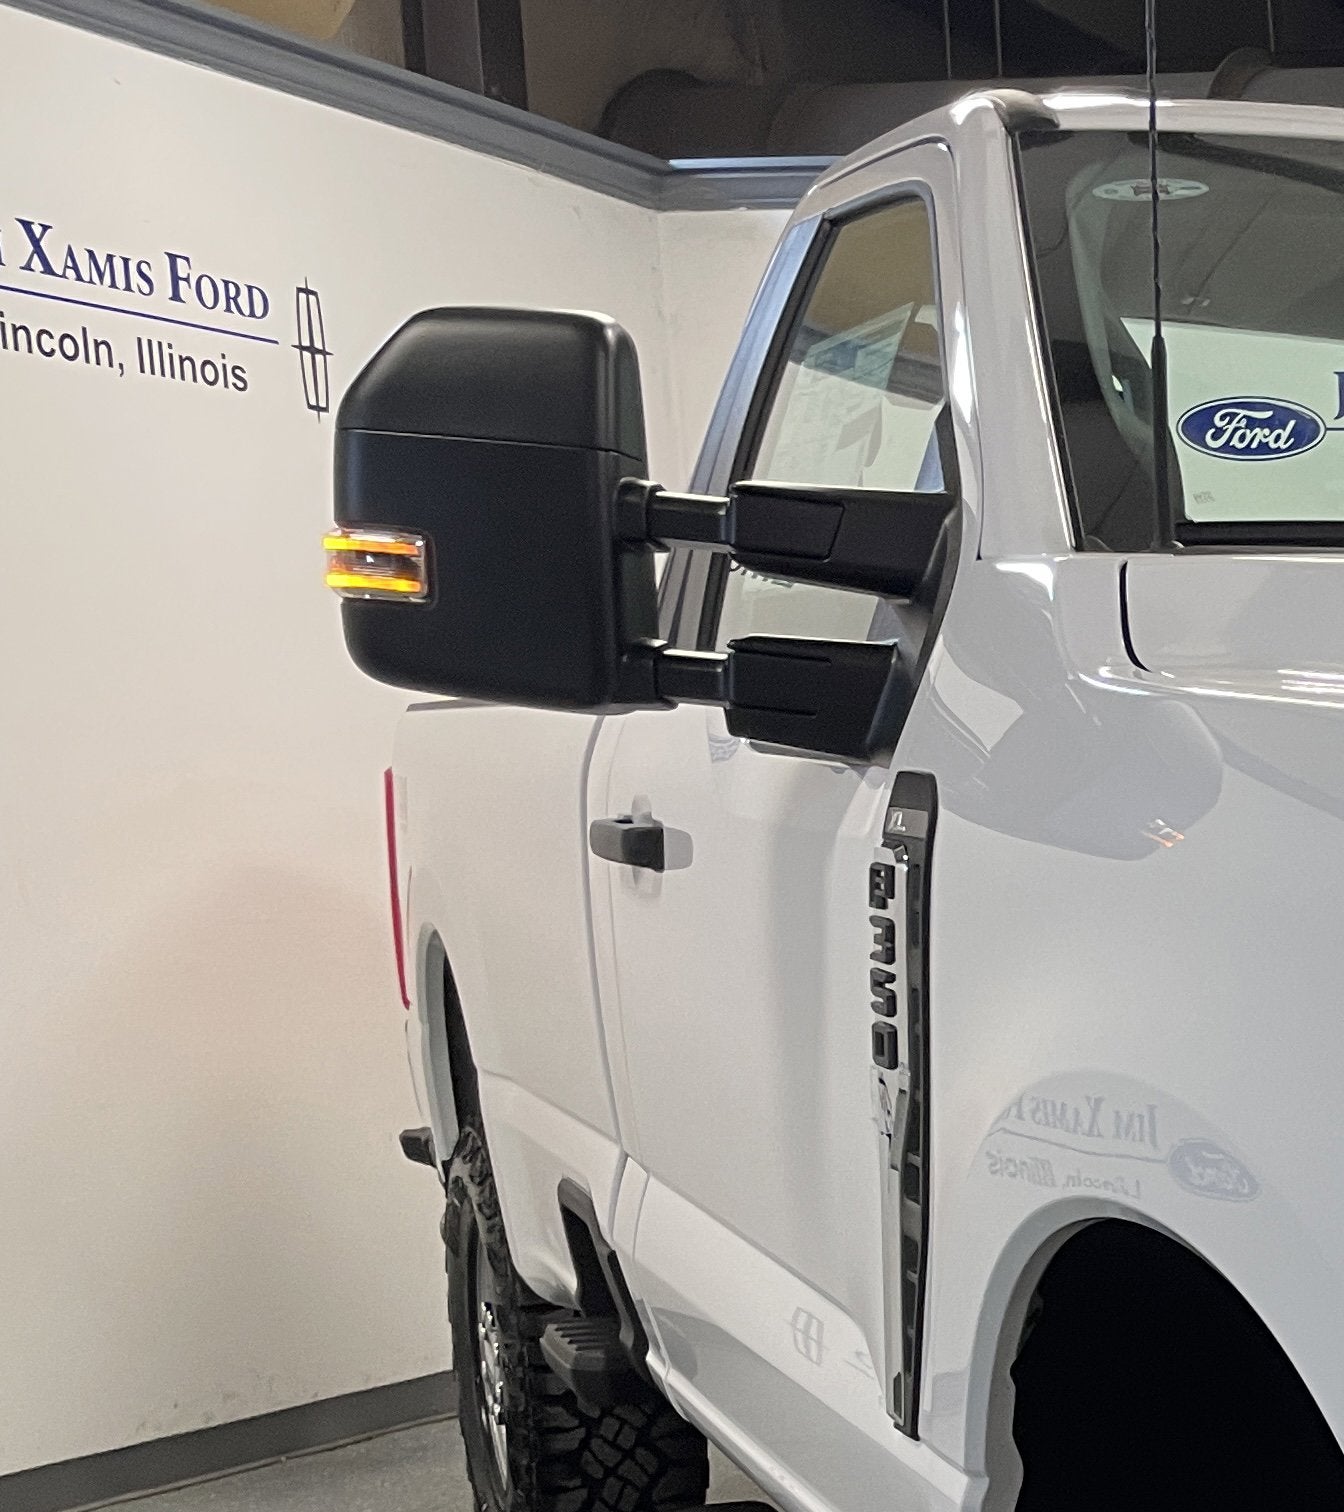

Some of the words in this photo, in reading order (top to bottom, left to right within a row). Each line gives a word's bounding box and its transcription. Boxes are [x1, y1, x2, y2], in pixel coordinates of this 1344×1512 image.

[163, 251, 271, 320] FORD
[0, 310, 125, 378] incoln,
[136, 336, 249, 393] Illinois
[1203, 408, 1296, 453] Ford
